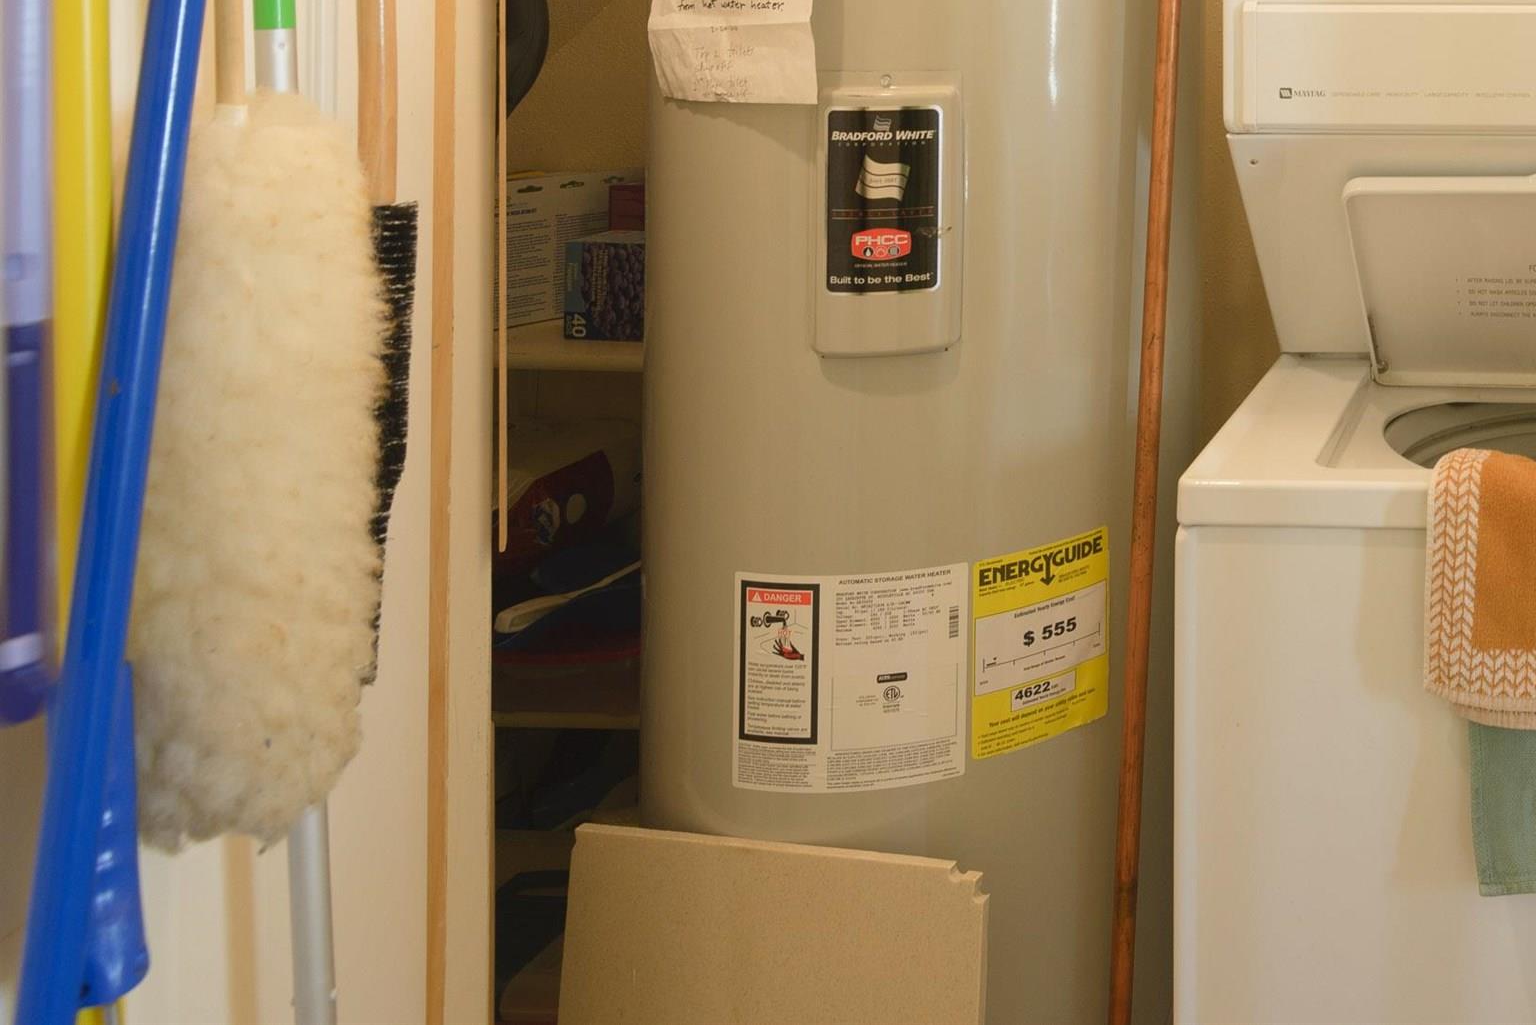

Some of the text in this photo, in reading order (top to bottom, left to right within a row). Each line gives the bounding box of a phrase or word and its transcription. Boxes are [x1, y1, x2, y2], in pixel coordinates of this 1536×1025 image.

[721, 0, 745, 8] water
[1293, 90, 1326, 98] MAYTAG
[832, 130, 934, 141] BRADFORD WHITE
[855, 234, 908, 245] PHCC
[830, 273, 931, 285] Built to be the Best
[572, 313, 587, 337] 40
[979, 535, 1103, 586] ENERGYGUIDE
[764, 593, 802, 603] DANGER
[1023, 616, 1077, 647] $ 555
[1015, 681, 1051, 700] 4622
